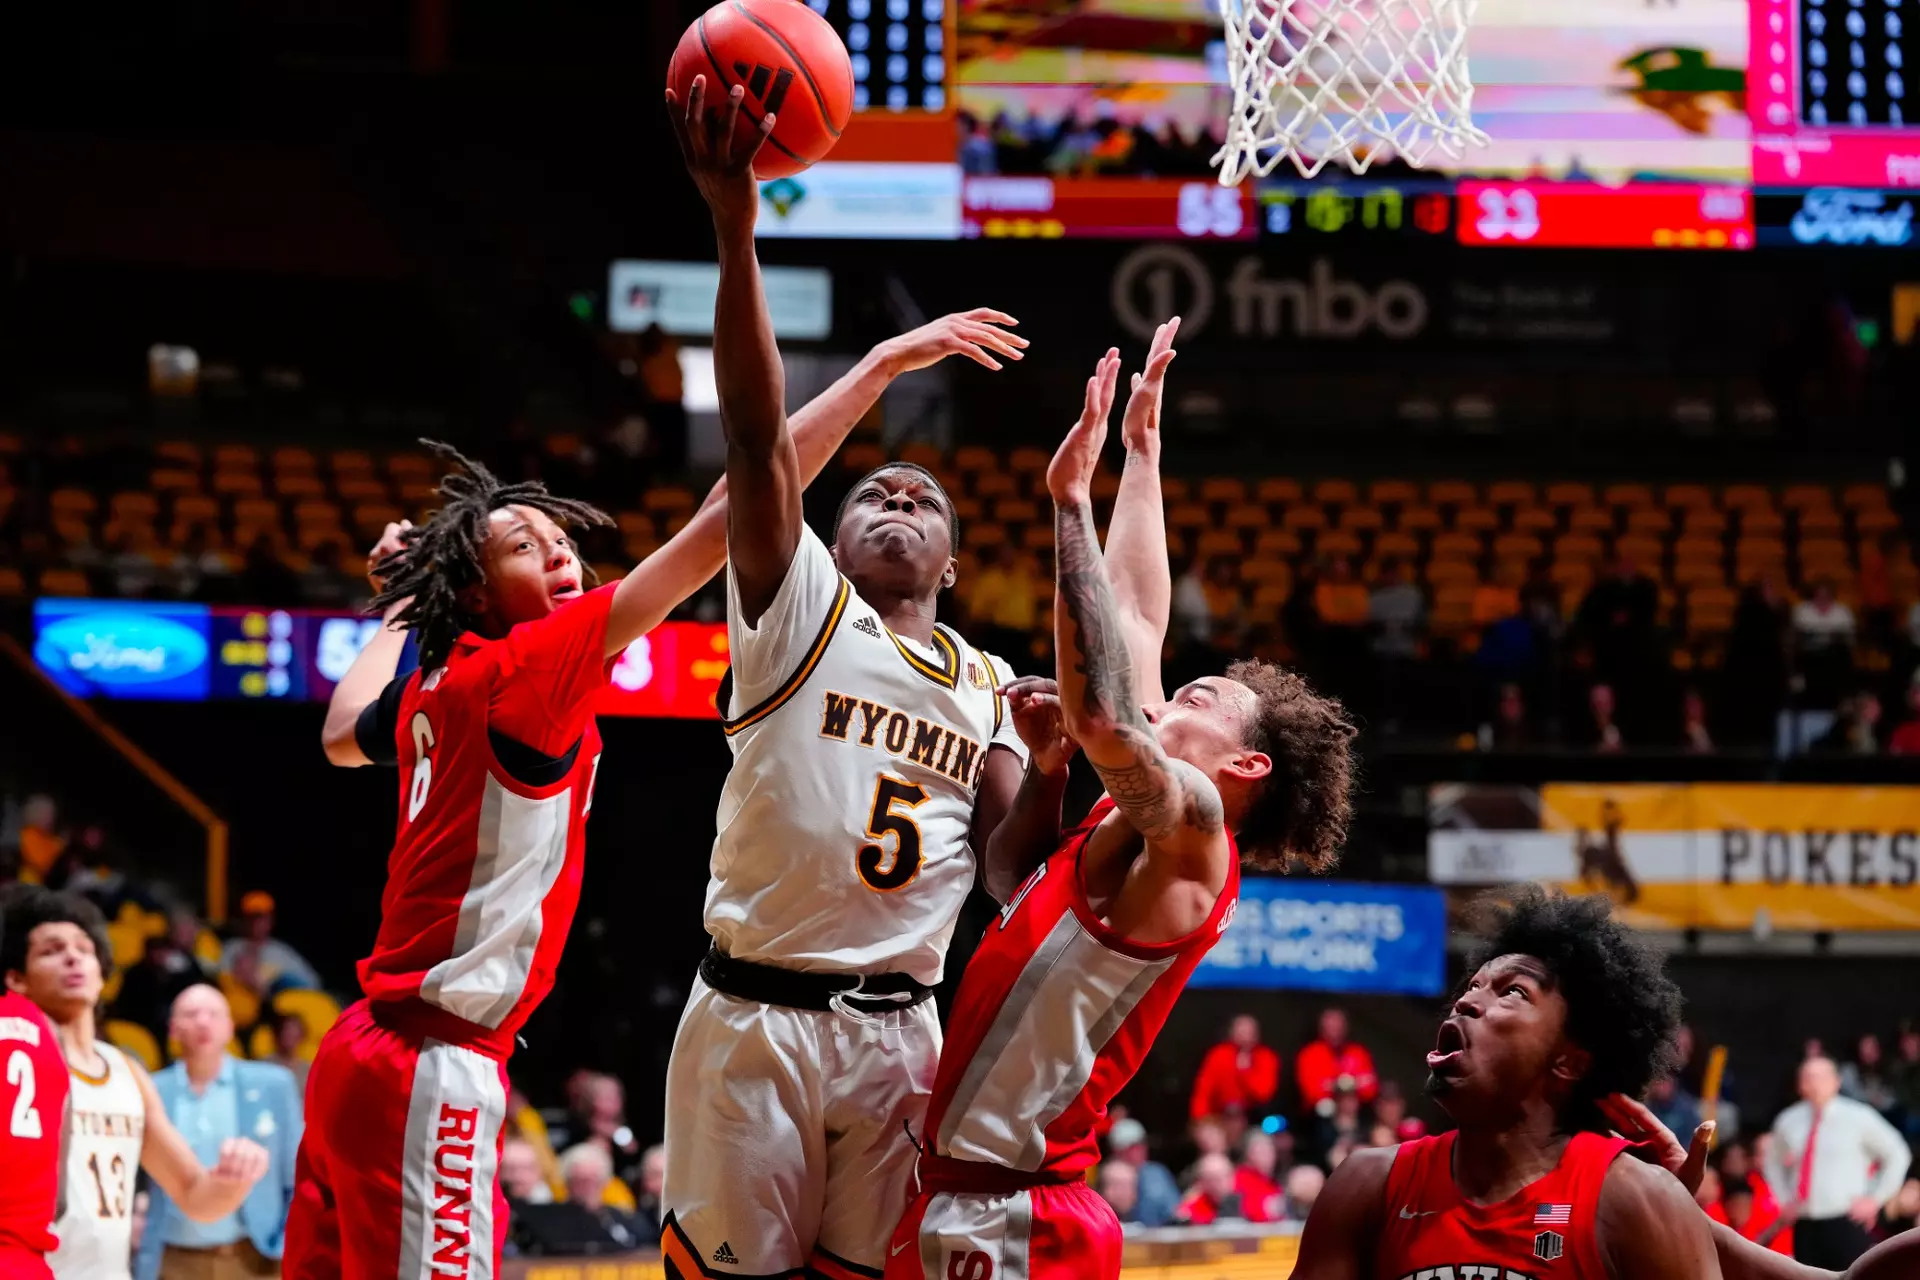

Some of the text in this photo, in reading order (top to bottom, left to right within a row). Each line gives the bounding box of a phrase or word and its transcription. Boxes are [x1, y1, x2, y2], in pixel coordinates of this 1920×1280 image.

[1791, 186, 1914, 245] Ford
[852, 620, 881, 640] adidas
[407, 711, 435, 824] 6
[855, 772, 932, 893] 5
[1720, 828, 1920, 887] POKES
[1268, 898, 1405, 942] SPORTS
[7, 1049, 43, 1139] 2
[88, 1152, 126, 1219] 13
[713, 1253, 739, 1265] adidas
